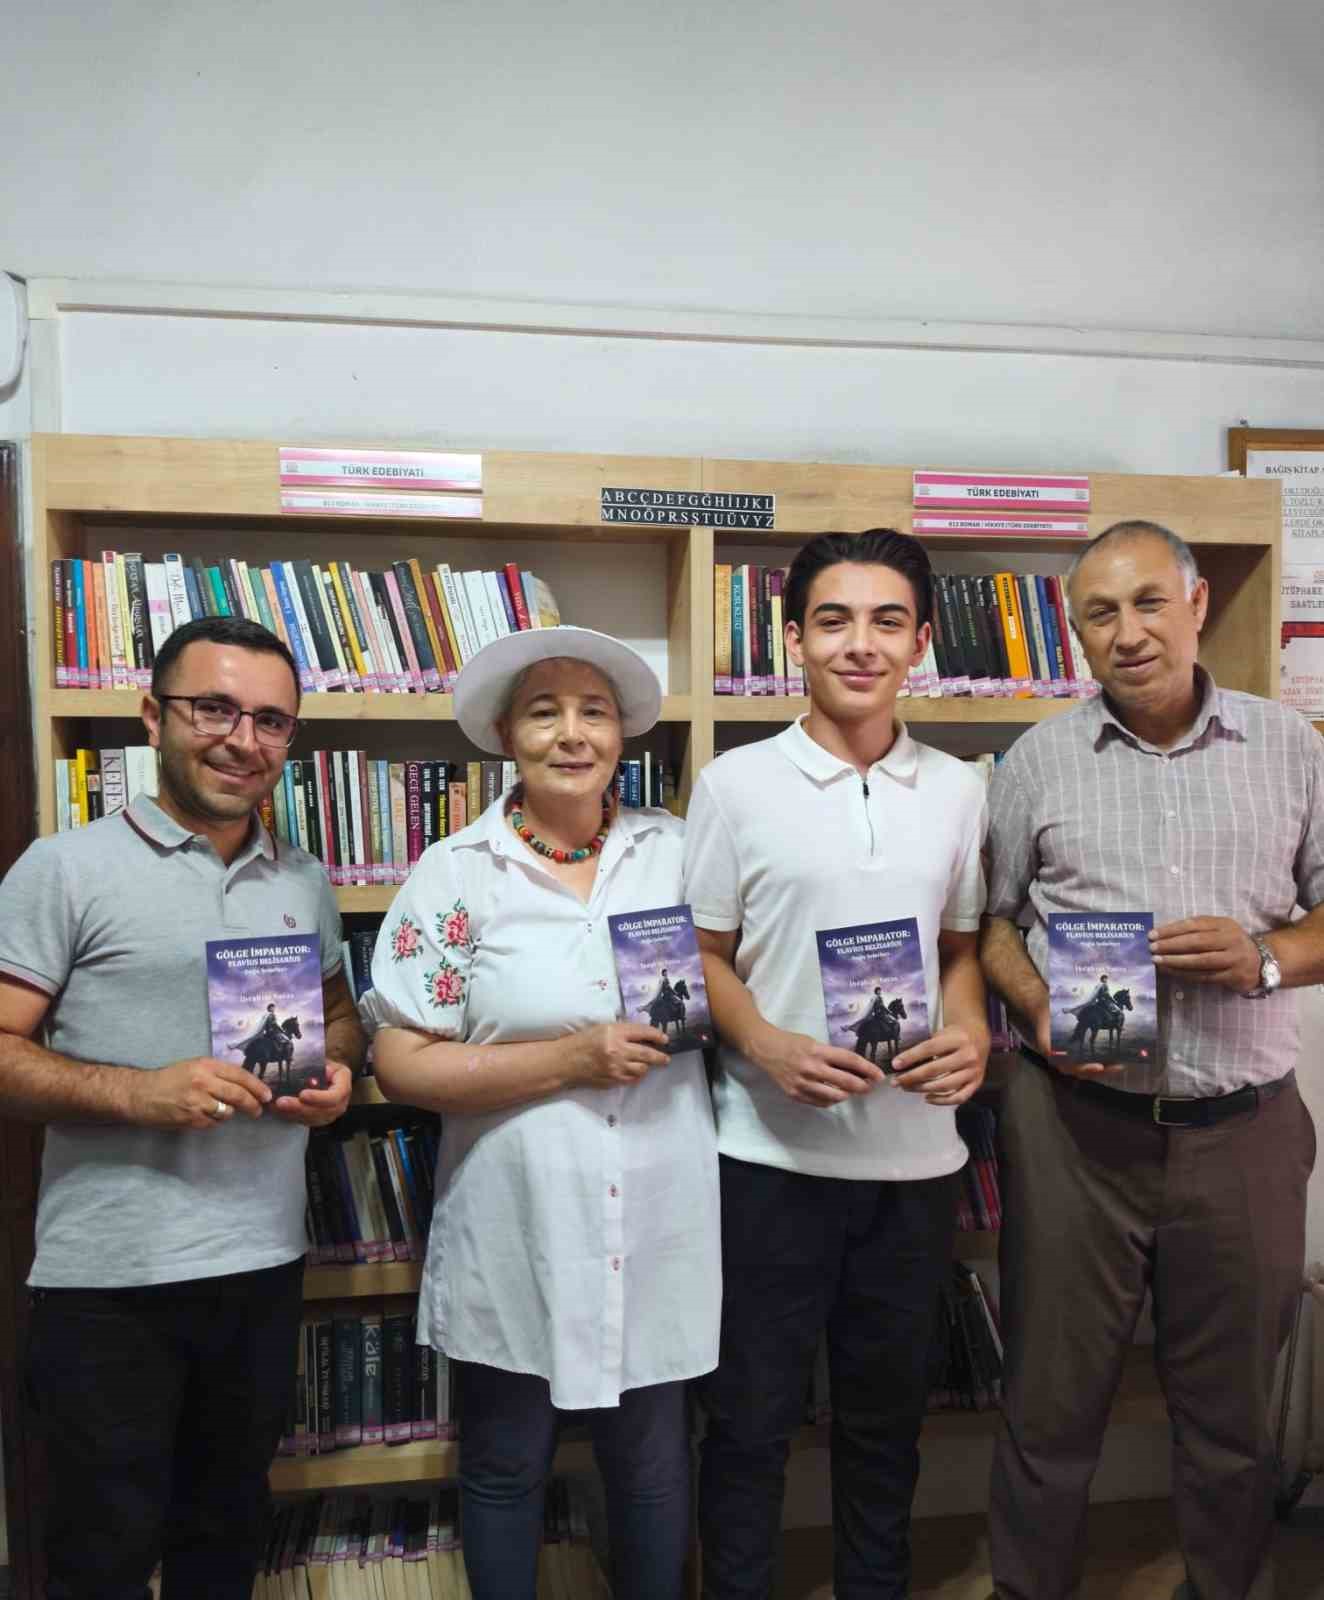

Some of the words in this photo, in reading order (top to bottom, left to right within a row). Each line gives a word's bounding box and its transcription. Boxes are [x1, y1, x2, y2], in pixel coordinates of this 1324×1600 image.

[341, 464, 370, 476] TÜRK
[967, 486, 992, 498] TÜRK
[993, 487, 1039, 498] EDEBİYATI
[408, 764, 419, 793] GECE
[409, 794, 420, 830] GELEN
[1055, 922, 1085, 931] GÖLGE
[825, 937, 855, 948] GÖLGE
[216, 948, 249, 960] GÖLGE
